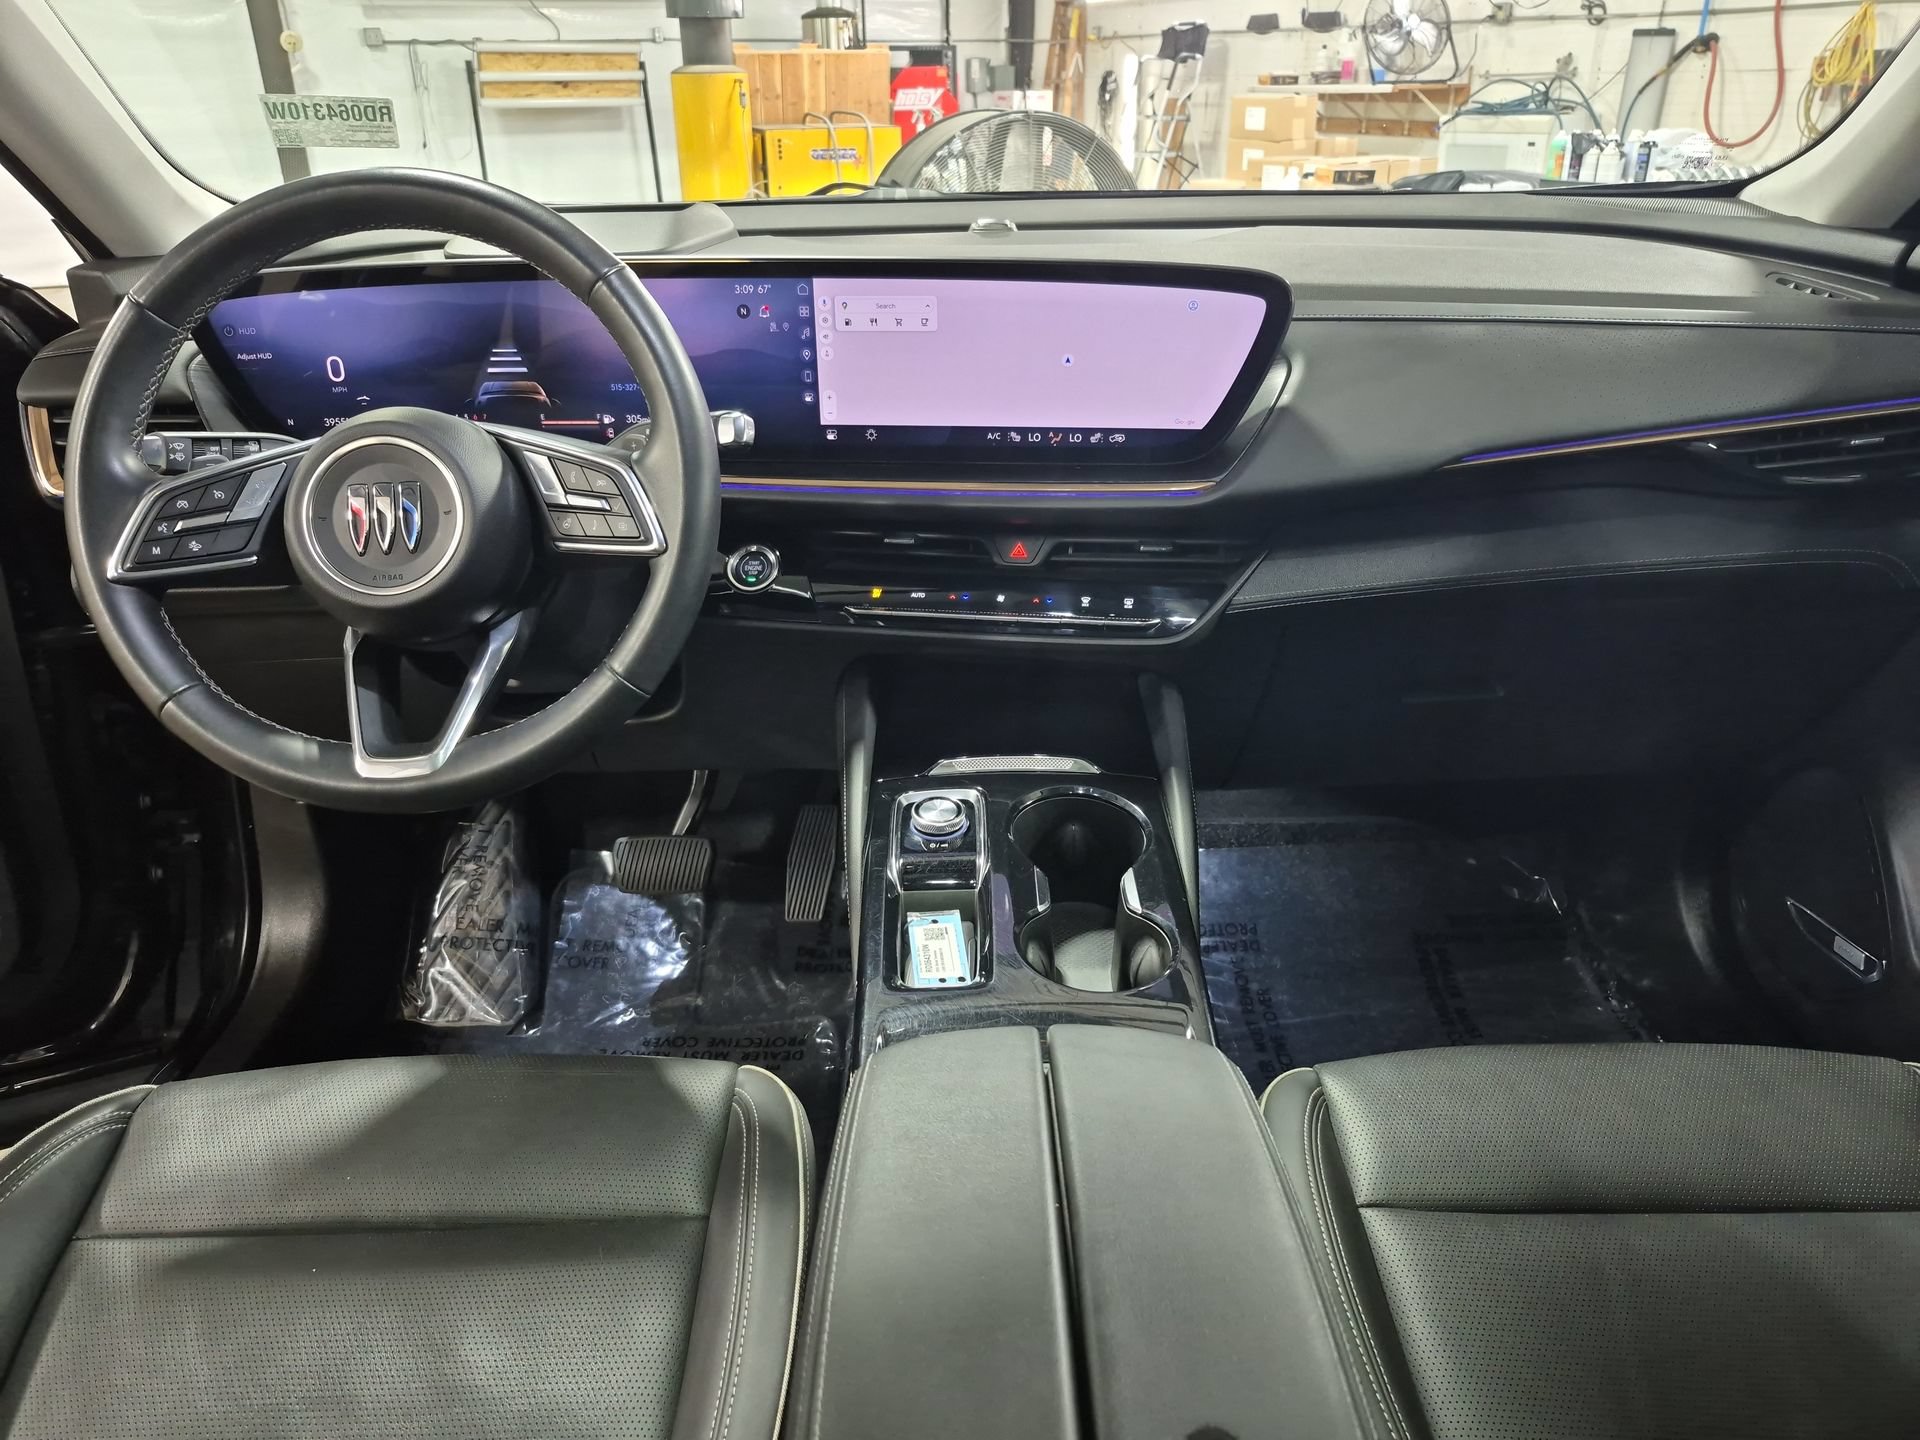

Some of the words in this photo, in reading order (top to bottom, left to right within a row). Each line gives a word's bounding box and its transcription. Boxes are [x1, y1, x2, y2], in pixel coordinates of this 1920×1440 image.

[811, 148, 857, 161] GEER
[735, 284, 754, 294] 3:09
[757, 284, 772, 294] 67°
[875, 302, 897, 310] Search
[237, 353, 257, 361] Adjust
[326, 355, 346, 382] 0
[287, 418, 295, 426] N
[323, 417, 349, 427] 3955
[1028, 433, 1041, 442] LO
[1069, 433, 1082, 442] LO
[152, 546, 161, 555] M
[372, 573, 404, 582] AIRBAG
[642, 1036, 699, 1048] COVER
[741, 1049, 804, 1061] DEALER
